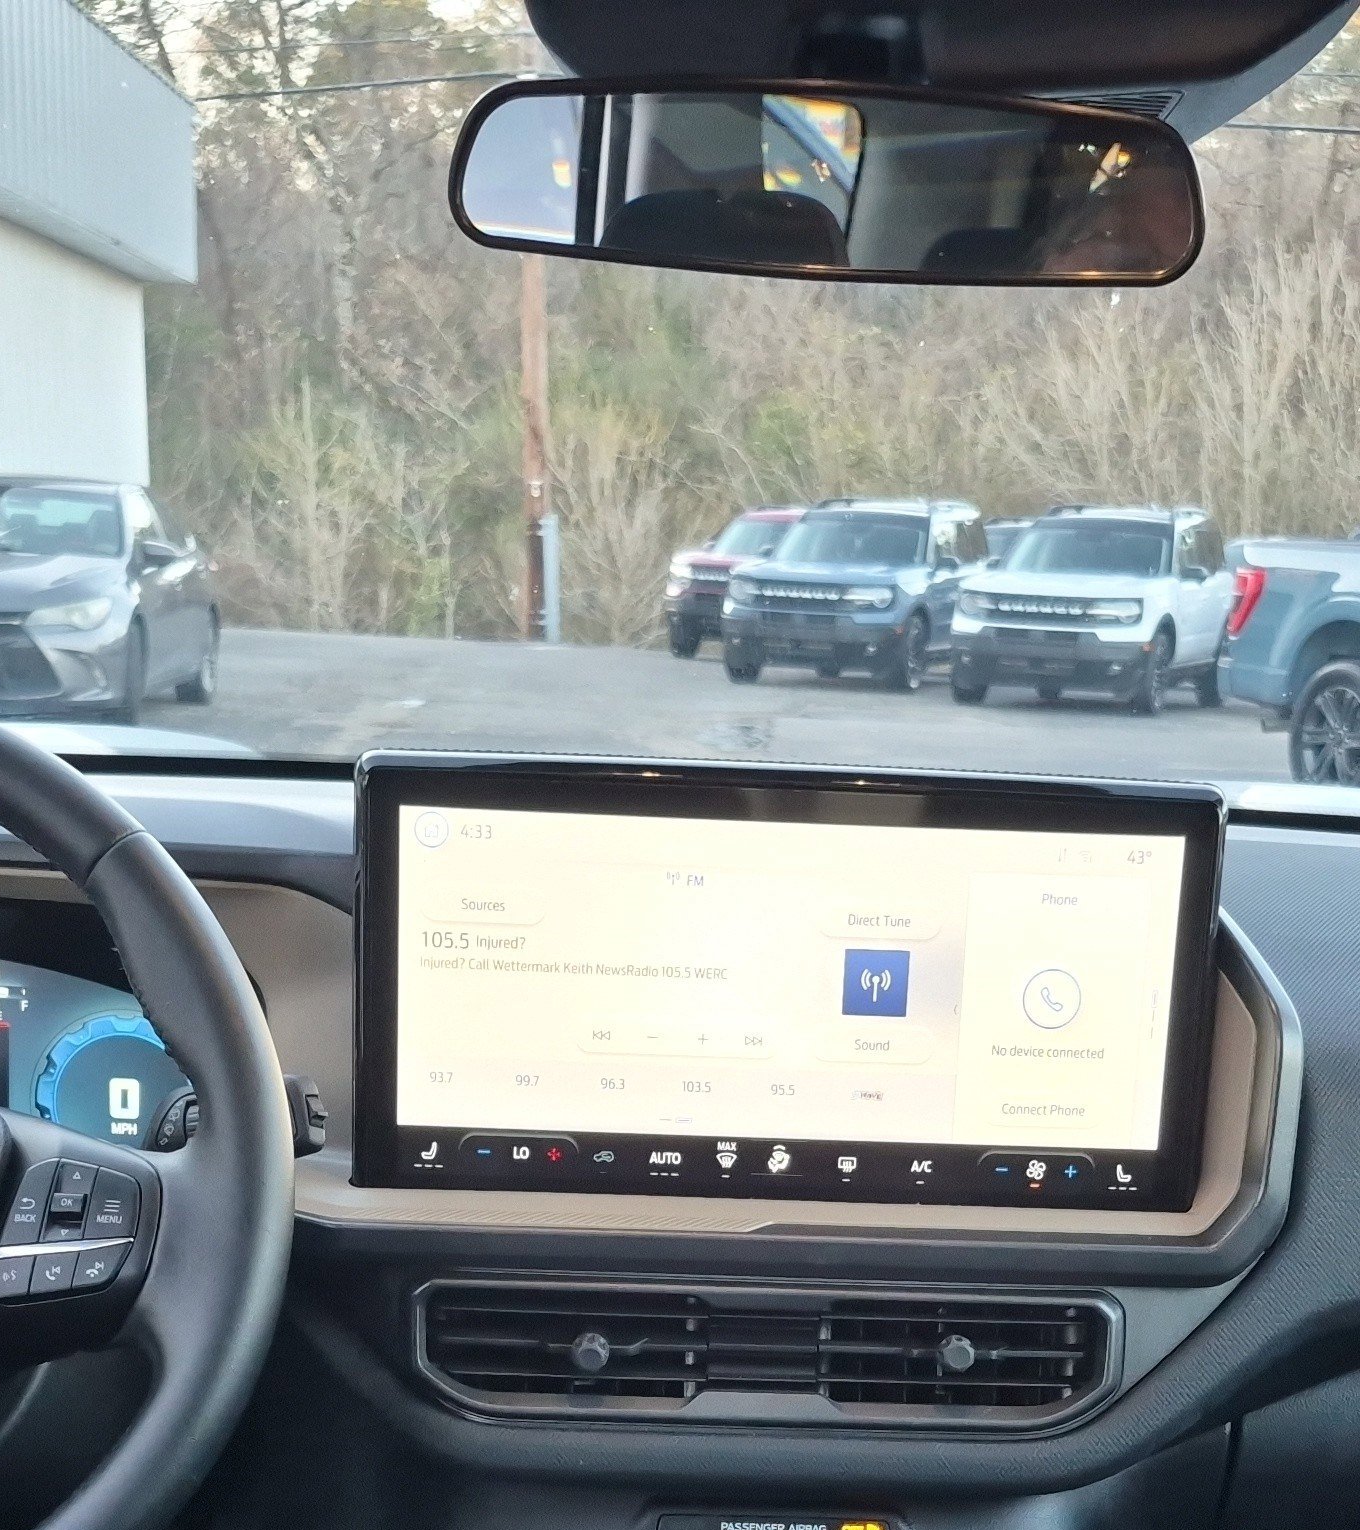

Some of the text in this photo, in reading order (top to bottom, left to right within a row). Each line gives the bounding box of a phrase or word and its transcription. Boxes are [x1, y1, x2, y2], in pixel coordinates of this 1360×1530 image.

[460, 825, 493, 840] 4:33
[1127, 850, 1153, 865] 43°
[687, 876, 704, 886] FM
[461, 898, 505, 912] Sources
[1042, 893, 1078, 906] Phone
[848, 914, 911, 928] Direct Tune
[422, 931, 526, 951] 105.5 Injured?
[420, 956, 728, 980] Injured? Call Wettermark Keith NewsRadio 105.5 WERC
[22, 1000, 29, 1012] F
[854, 1039, 890, 1051] Sound
[992, 1045, 1105, 1060] No device connected
[430, 1072, 453, 1084] 93.7
[515, 1075, 540, 1087] 99.7
[600, 1078, 625, 1090] 96.3
[682, 1081, 712, 1093] 103.5
[771, 1084, 795, 1096] 95.5
[109, 1078, 140, 1119] 0
[1002, 1103, 1085, 1118] Connect Phone
[111, 1123, 137, 1136] MPH
[717, 1141, 737, 1151] MAX
[513, 1147, 529, 1160] LO
[650, 1152, 681, 1165] AUTO
[911, 1160, 932, 1173] A/C
[61, 1198, 73, 1207] OK
[14, 1214, 37, 1223] BACK
[97, 1215, 123, 1224] MENU
